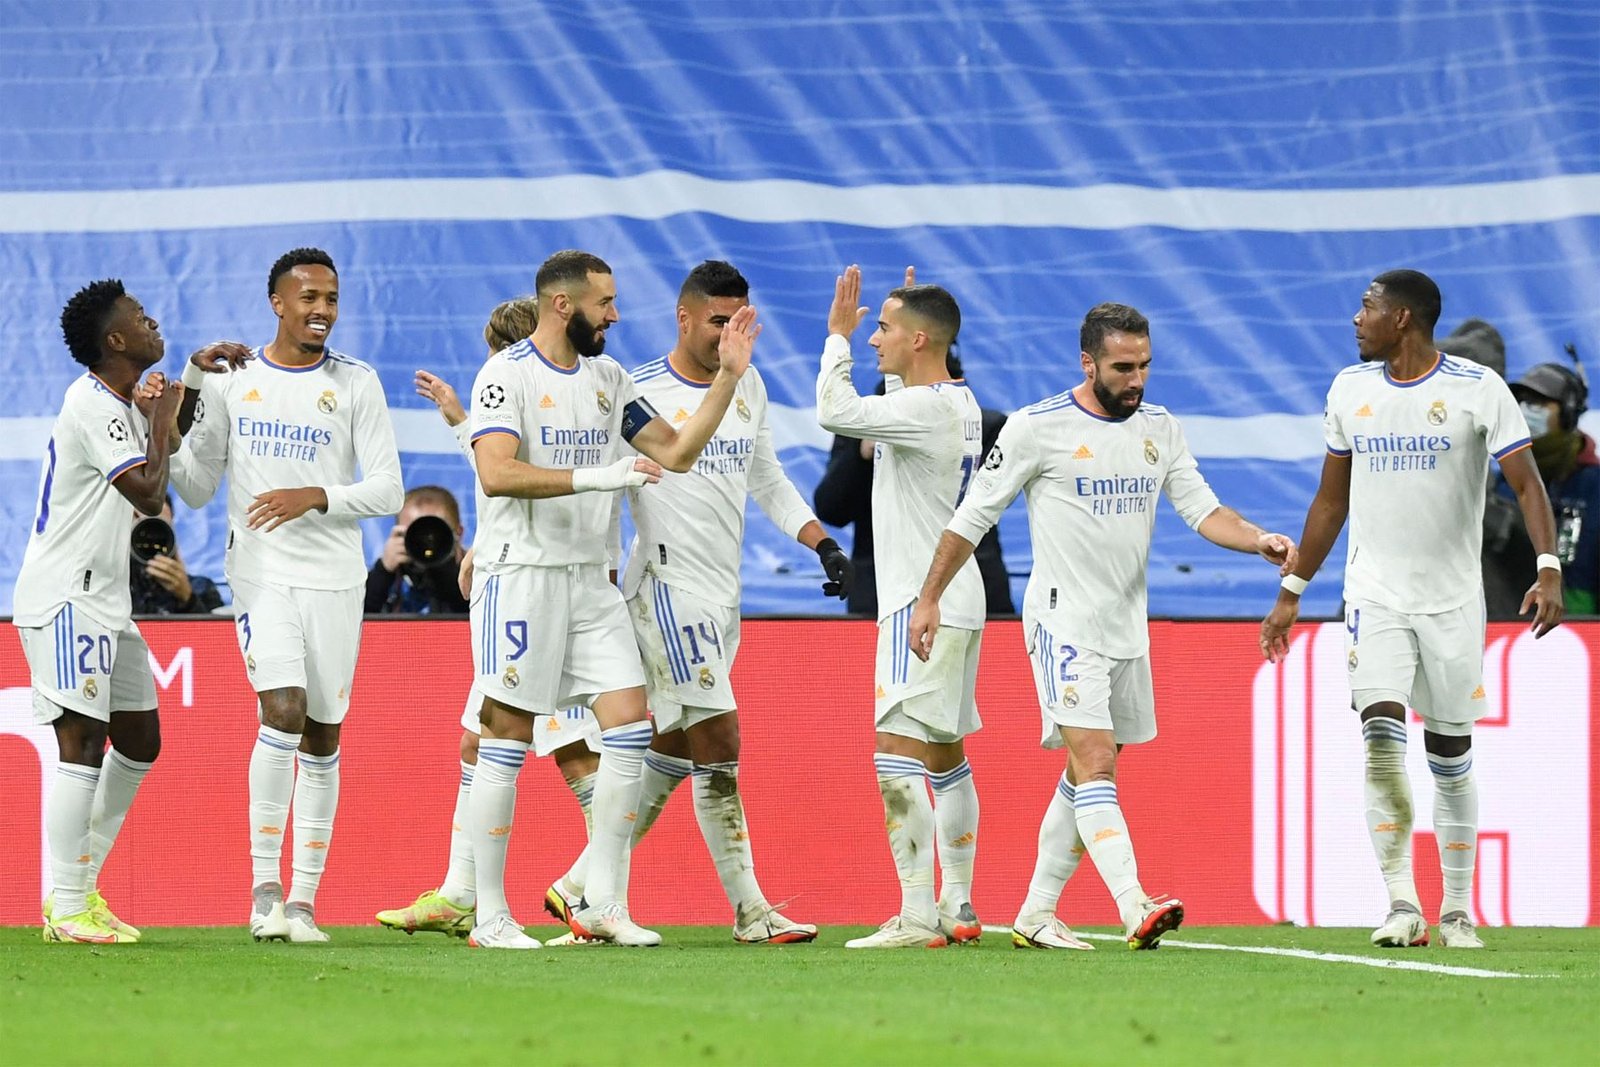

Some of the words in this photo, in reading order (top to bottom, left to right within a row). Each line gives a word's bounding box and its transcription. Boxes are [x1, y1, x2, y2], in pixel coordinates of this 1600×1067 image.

[238, 416, 332, 446] Emirates
[540, 425, 609, 446] Emrates
[1353, 432, 1451, 454] Emirates
[250, 439, 269, 456] FLY
[273, 441, 316, 462] BETTER
[553, 448, 571, 465] FLY
[573, 448, 601, 465] ETTER
[703, 435, 755, 457] mirate
[1370, 456, 1388, 472] FLY
[1392, 454, 1436, 471] BETTER
[1093, 499, 1112, 516] FLY
[238, 612, 252, 653] 3
[506, 620, 528, 661] 9
[1346, 609, 1360, 646] 4
[77, 634, 112, 675] 20
[682, 621, 722, 665] 14
[1060, 645, 1079, 681] 2
